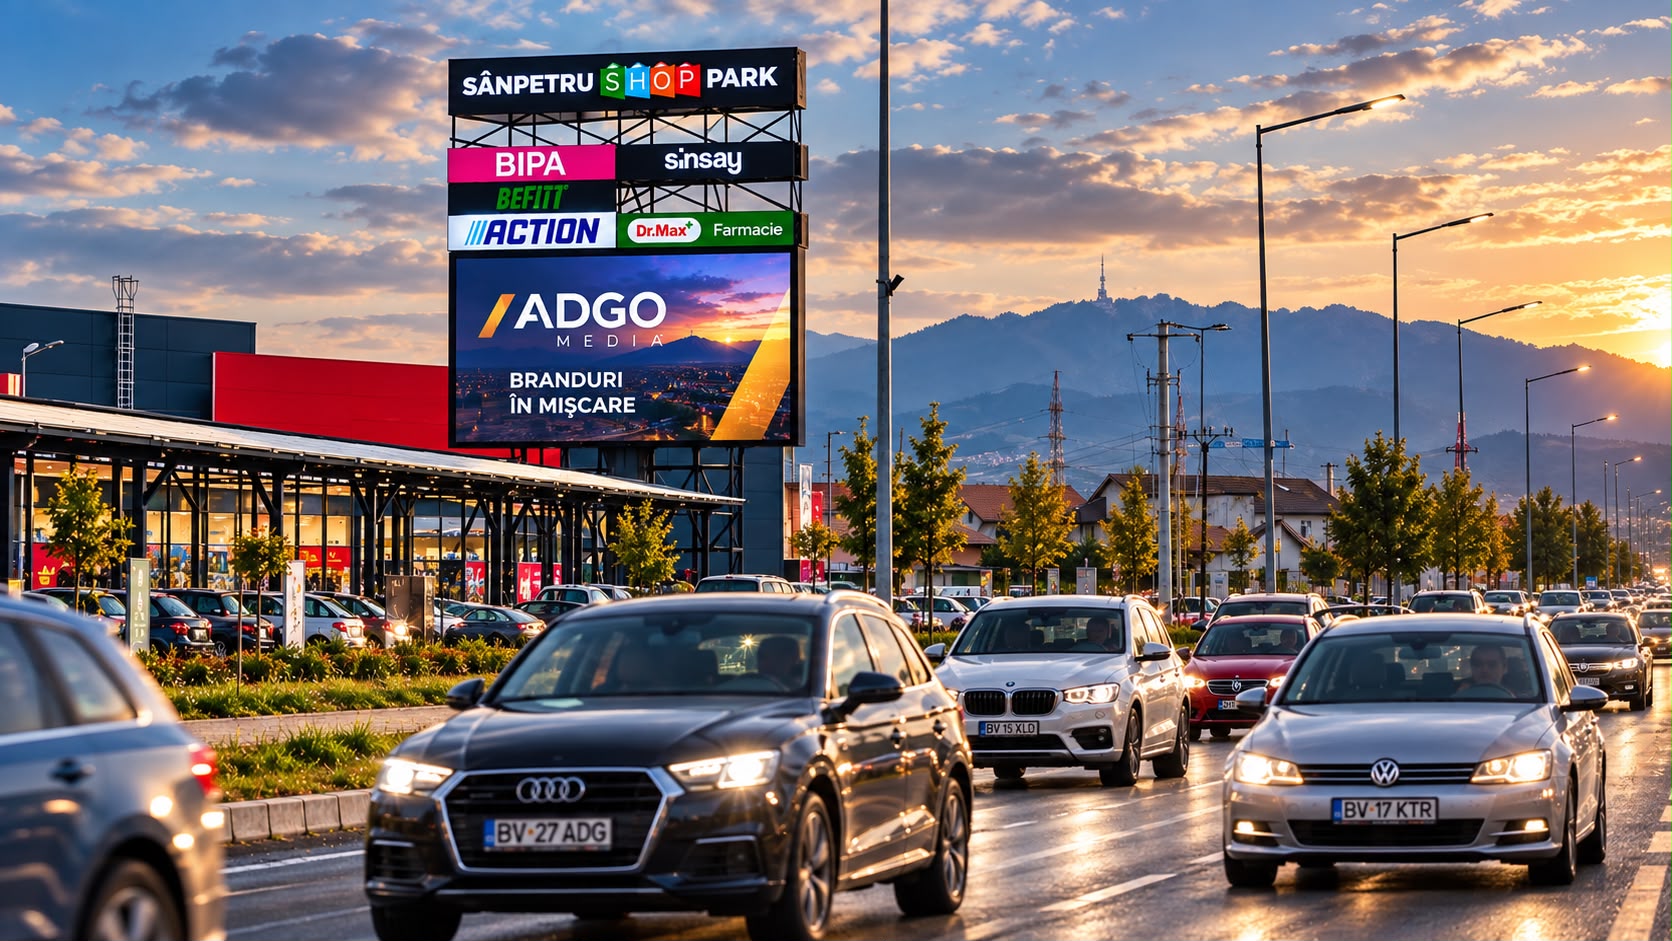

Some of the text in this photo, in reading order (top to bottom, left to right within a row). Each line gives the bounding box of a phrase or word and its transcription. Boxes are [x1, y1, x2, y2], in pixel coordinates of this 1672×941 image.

[462, 66, 778, 96] SÂNPETRU SHOP PARK
[495, 151, 567, 177] BIPA
[664, 147, 743, 175] sinsay
[484, 218, 601, 245] ACTION
[713, 223, 783, 237] Farmacie
[514, 291, 667, 329] ADGO
[557, 334, 663, 348] MEDIA
[510, 371, 623, 389] BRANDURI
[509, 393, 533, 414] ÎN
[986, 724, 1035, 733] BV 15 XLD
[1344, 801, 1369, 818] BV
[1376, 801, 1391, 818] 17
[1397, 801, 1432, 818] KTR
[497, 822, 606, 843] BV 27 ADG
